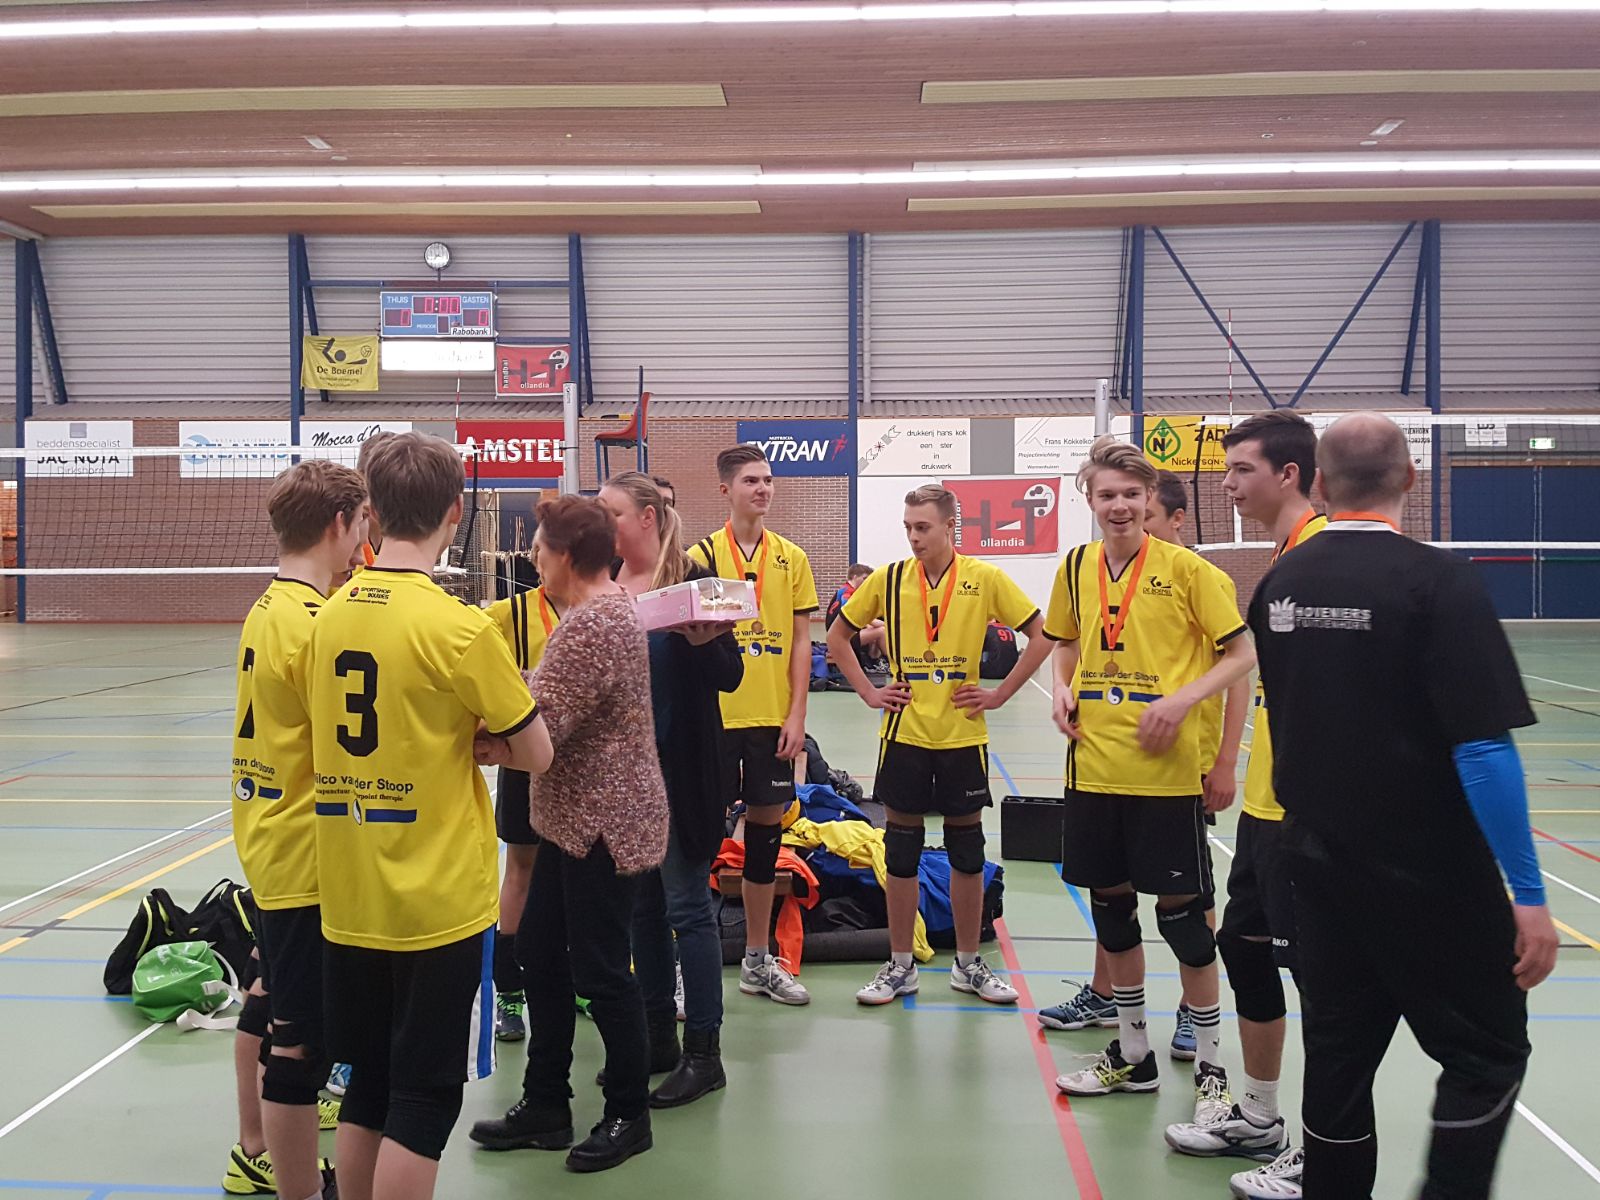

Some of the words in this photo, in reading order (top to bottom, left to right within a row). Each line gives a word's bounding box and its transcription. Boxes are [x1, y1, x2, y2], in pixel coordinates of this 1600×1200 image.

[452, 327, 489, 336] Rabobank
[316, 365, 329, 374] De
[331, 366, 363, 375] Boemel
[906, 429, 935, 438] drukkerij
[1194, 428, 1230, 442] ZAD
[36, 439, 121, 448] beddenspecialist
[311, 431, 355, 447] Mocca
[462, 436, 564, 463] AMSTEL
[939, 655, 951, 663] der
[334, 649, 379, 758] 3
[315, 773, 337, 785] ilco
[354, 777, 373, 789] der
[376, 778, 414, 795] Stoop
[1272, 937, 1289, 947] AKO
